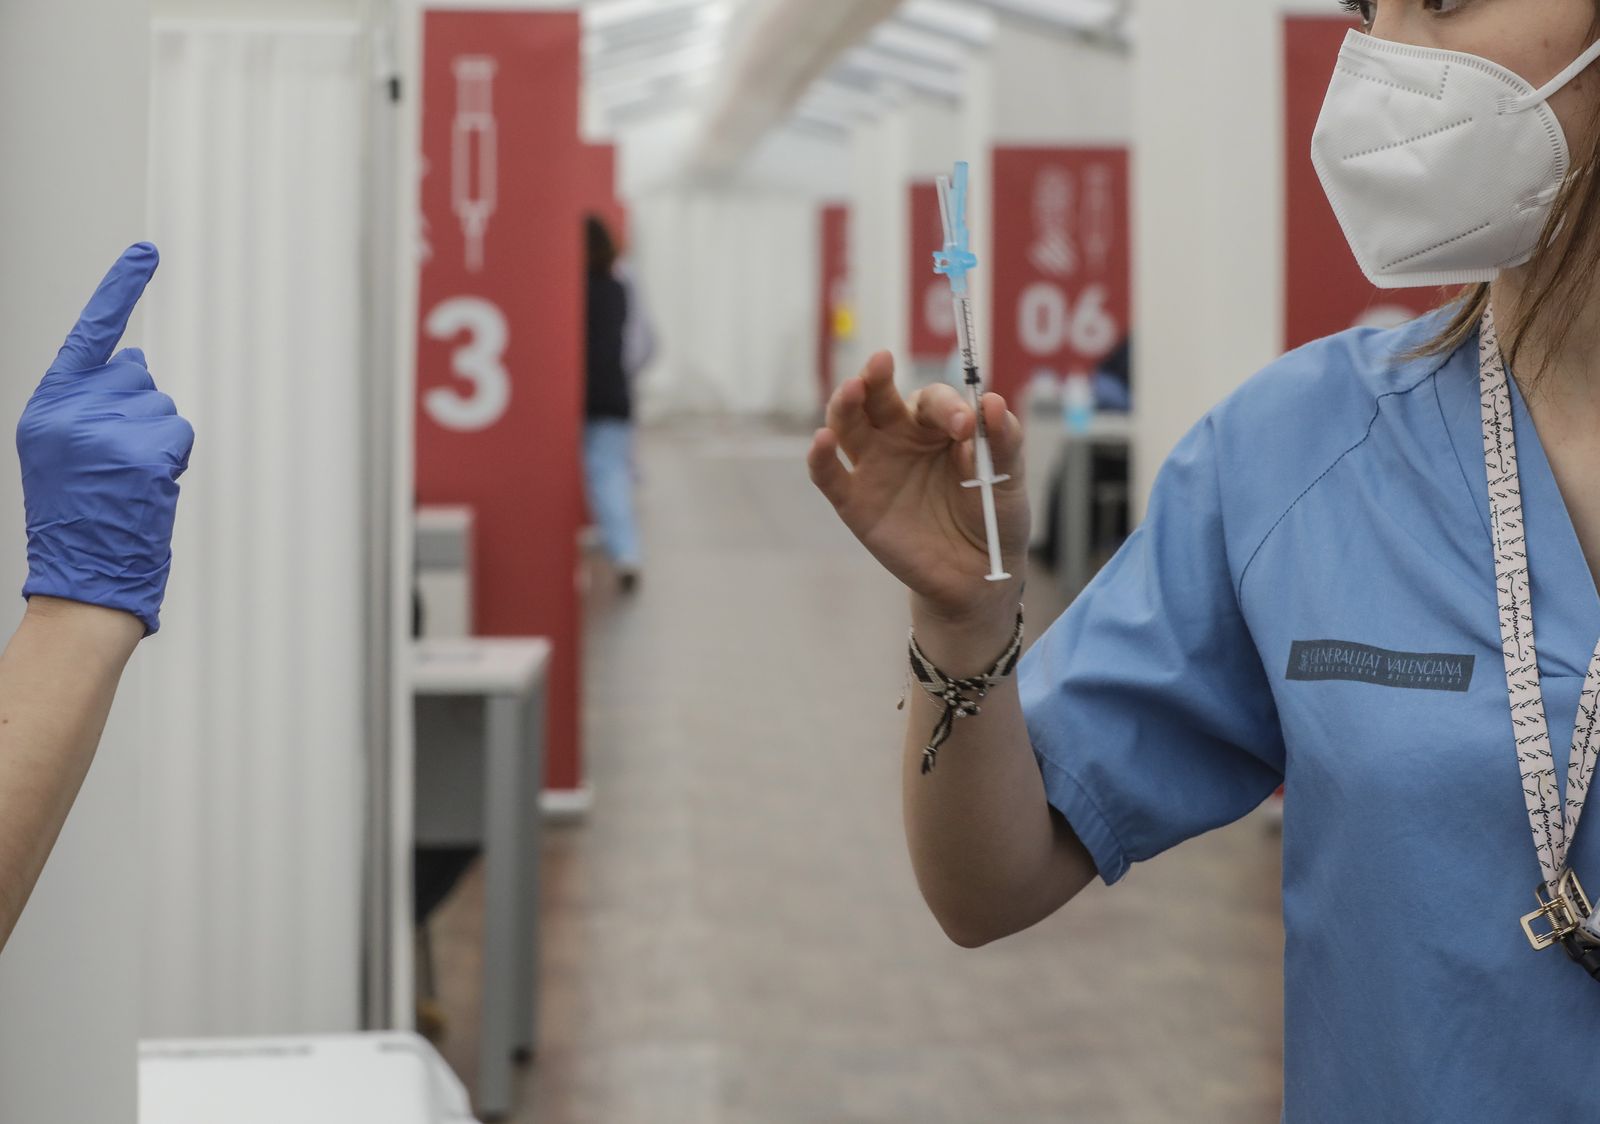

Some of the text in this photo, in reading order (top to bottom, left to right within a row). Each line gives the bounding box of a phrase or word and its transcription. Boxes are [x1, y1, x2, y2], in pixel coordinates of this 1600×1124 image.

[1018, 283, 1118, 357] 06
[425, 296, 512, 431] 3
[1310, 647, 1382, 670] GENERALITAT
[1387, 657, 1463, 678] VALENCIANA
